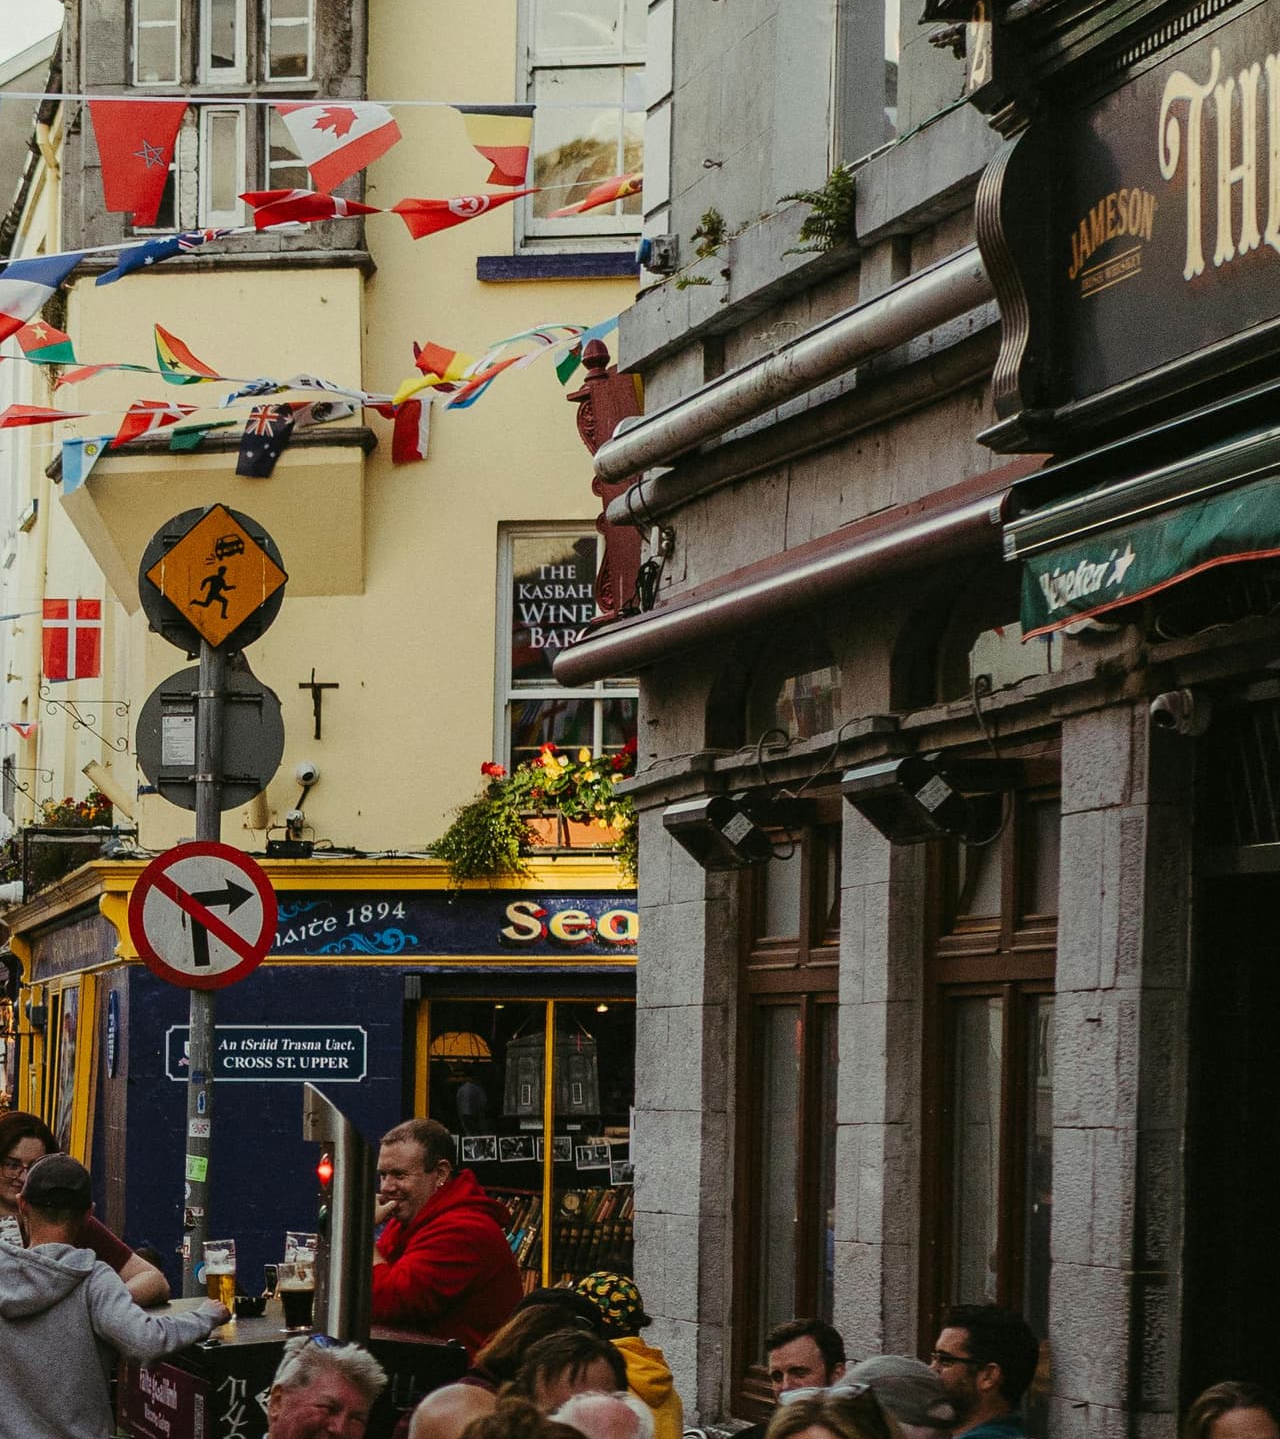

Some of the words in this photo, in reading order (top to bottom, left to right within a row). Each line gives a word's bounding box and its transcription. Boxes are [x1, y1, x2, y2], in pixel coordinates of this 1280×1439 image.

[1069, 188, 1157, 281] JAMESON
[540, 564, 576, 580] THE
[519, 584, 593, 599] KASBAH
[519, 603, 593, 624] WINE
[529, 627, 580, 649] BAR
[346, 900, 406, 928] 1894
[218, 1039, 237, 1050] An
[241, 1038, 278, 1050] tSráid
[282, 1038, 321, 1050] Trasna
[325, 1039, 355, 1050] Uact.
[223, 1056, 272, 1068] CROSS
[276, 1057, 296, 1068] ST.
[300, 1057, 349, 1069] UPPER
